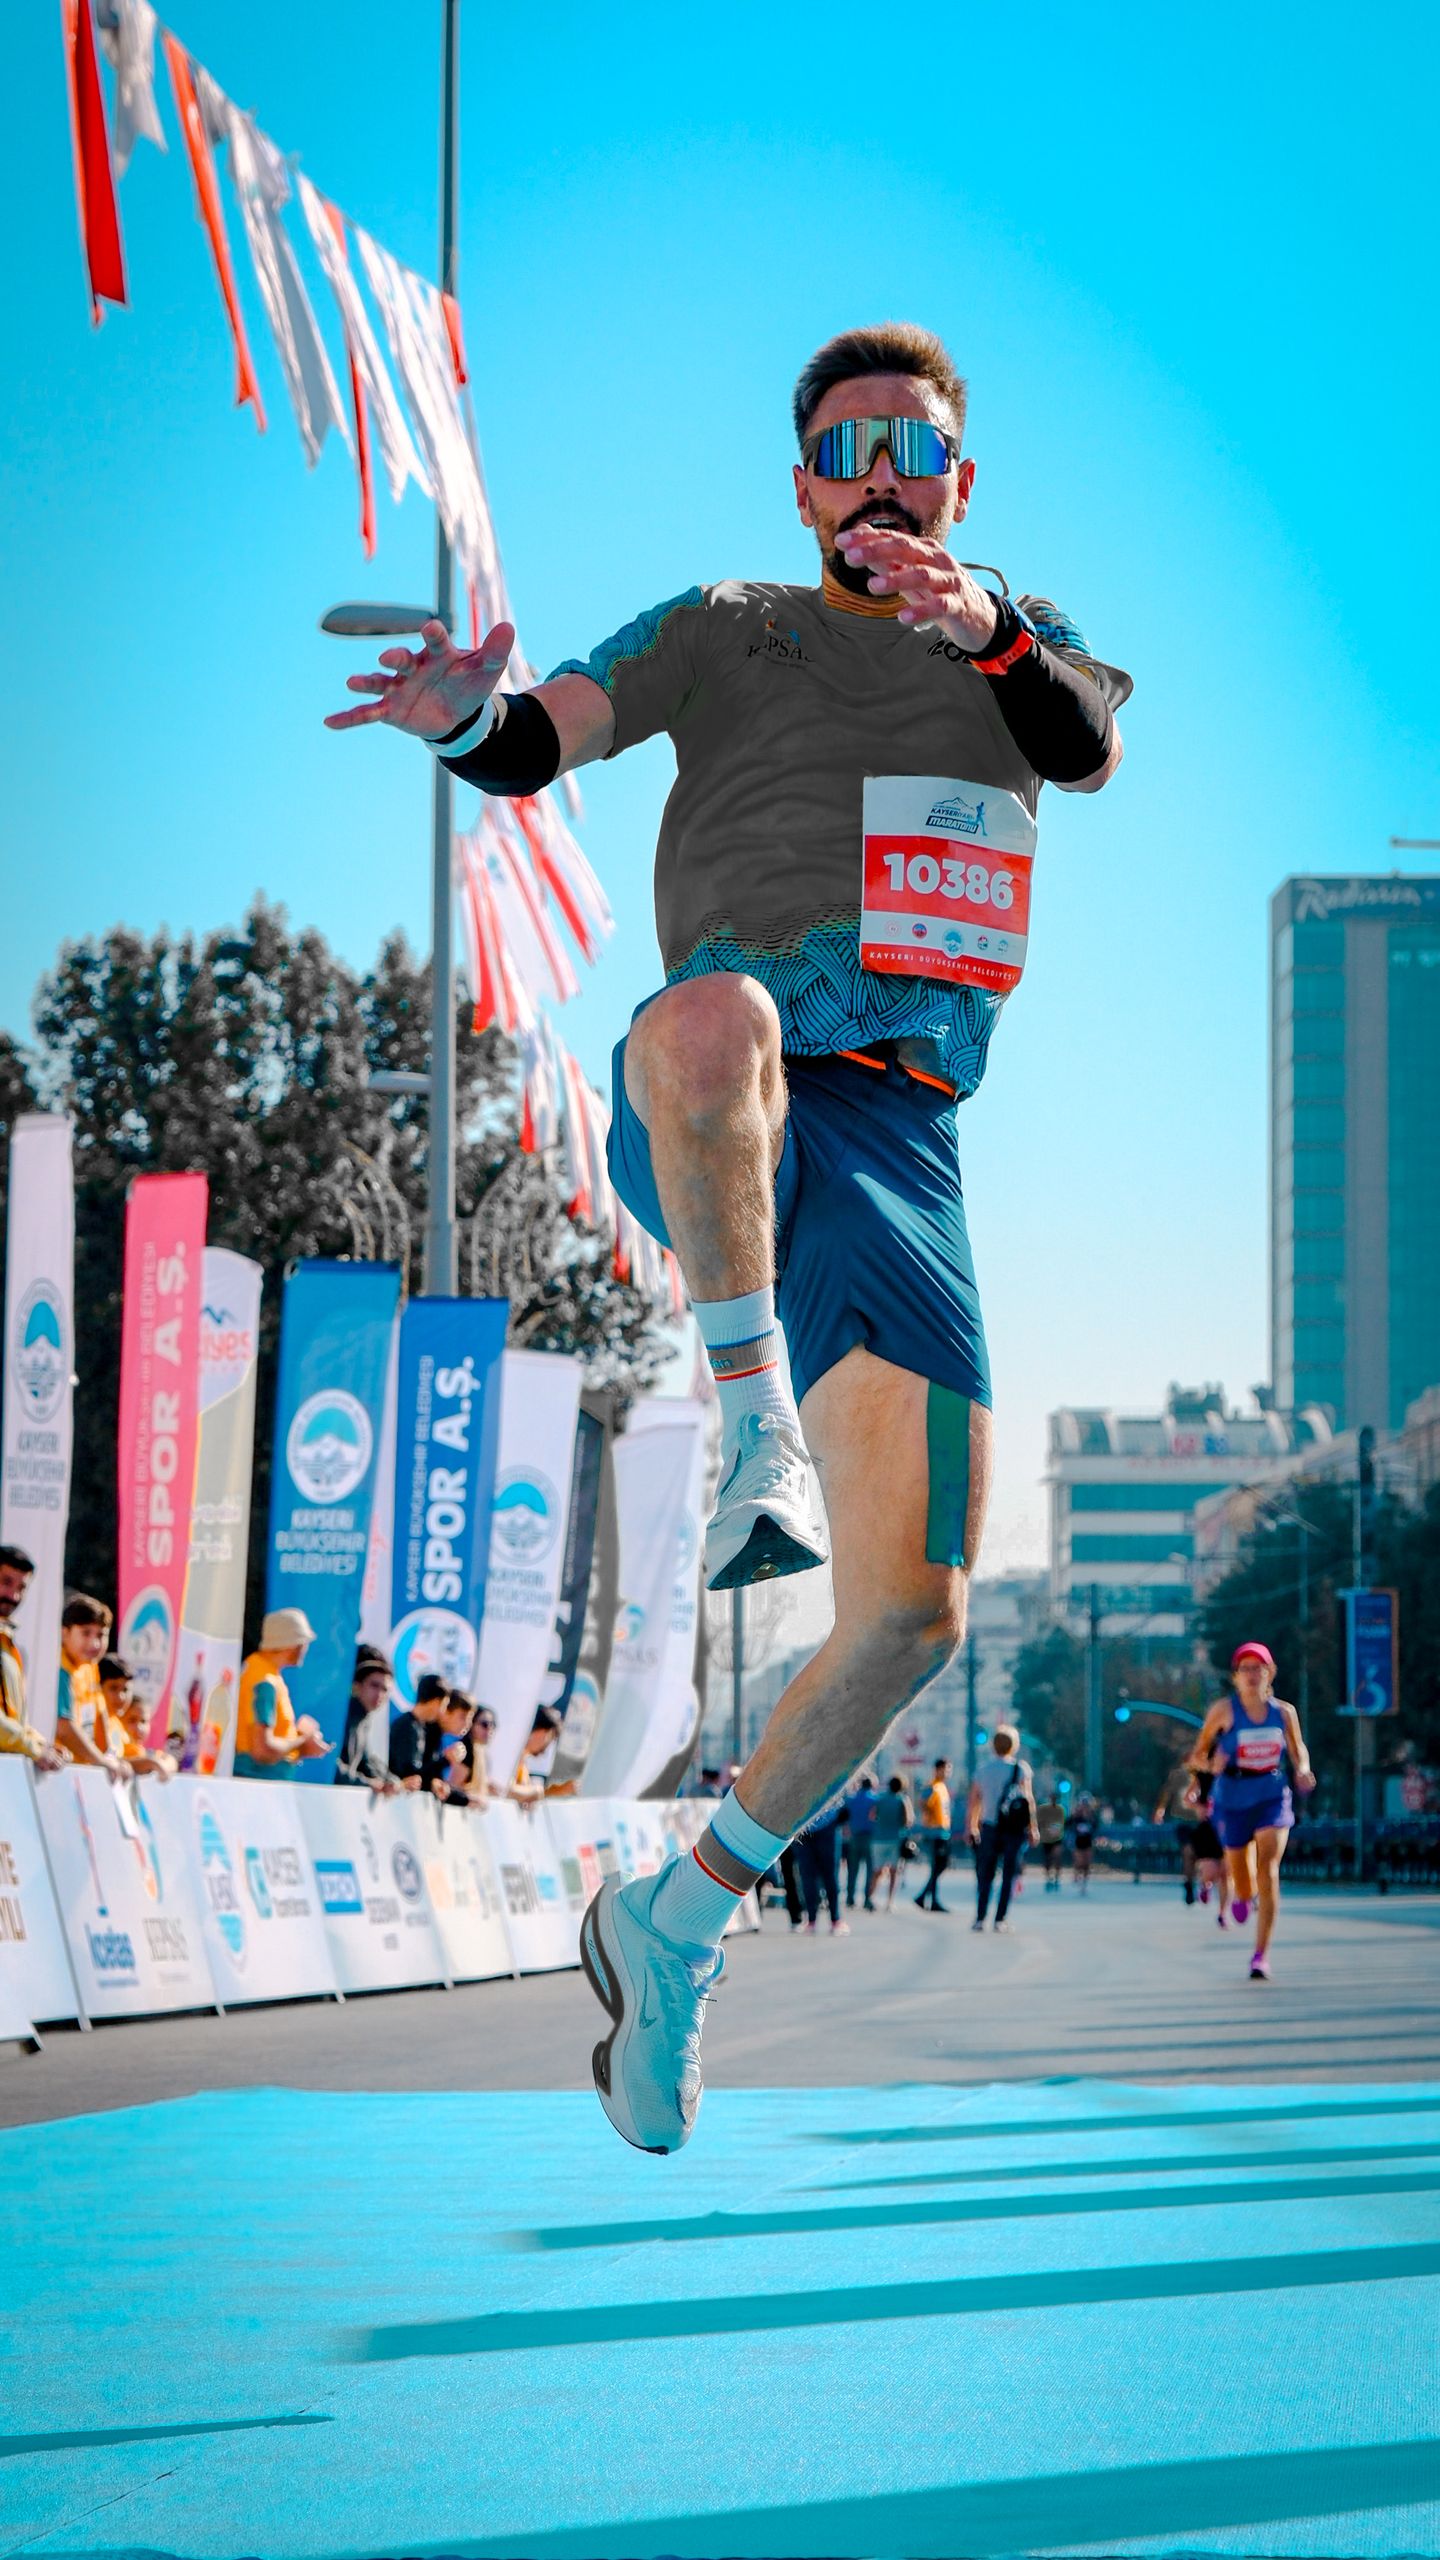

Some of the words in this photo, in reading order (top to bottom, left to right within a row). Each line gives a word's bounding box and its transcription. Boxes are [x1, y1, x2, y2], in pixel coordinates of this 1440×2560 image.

[883, 853, 1014, 910] 10386
[432, 1355, 481, 1453] A.Ş.
[147, 1390, 181, 1567] SPOR
[420, 1467, 467, 1602] SPOR
